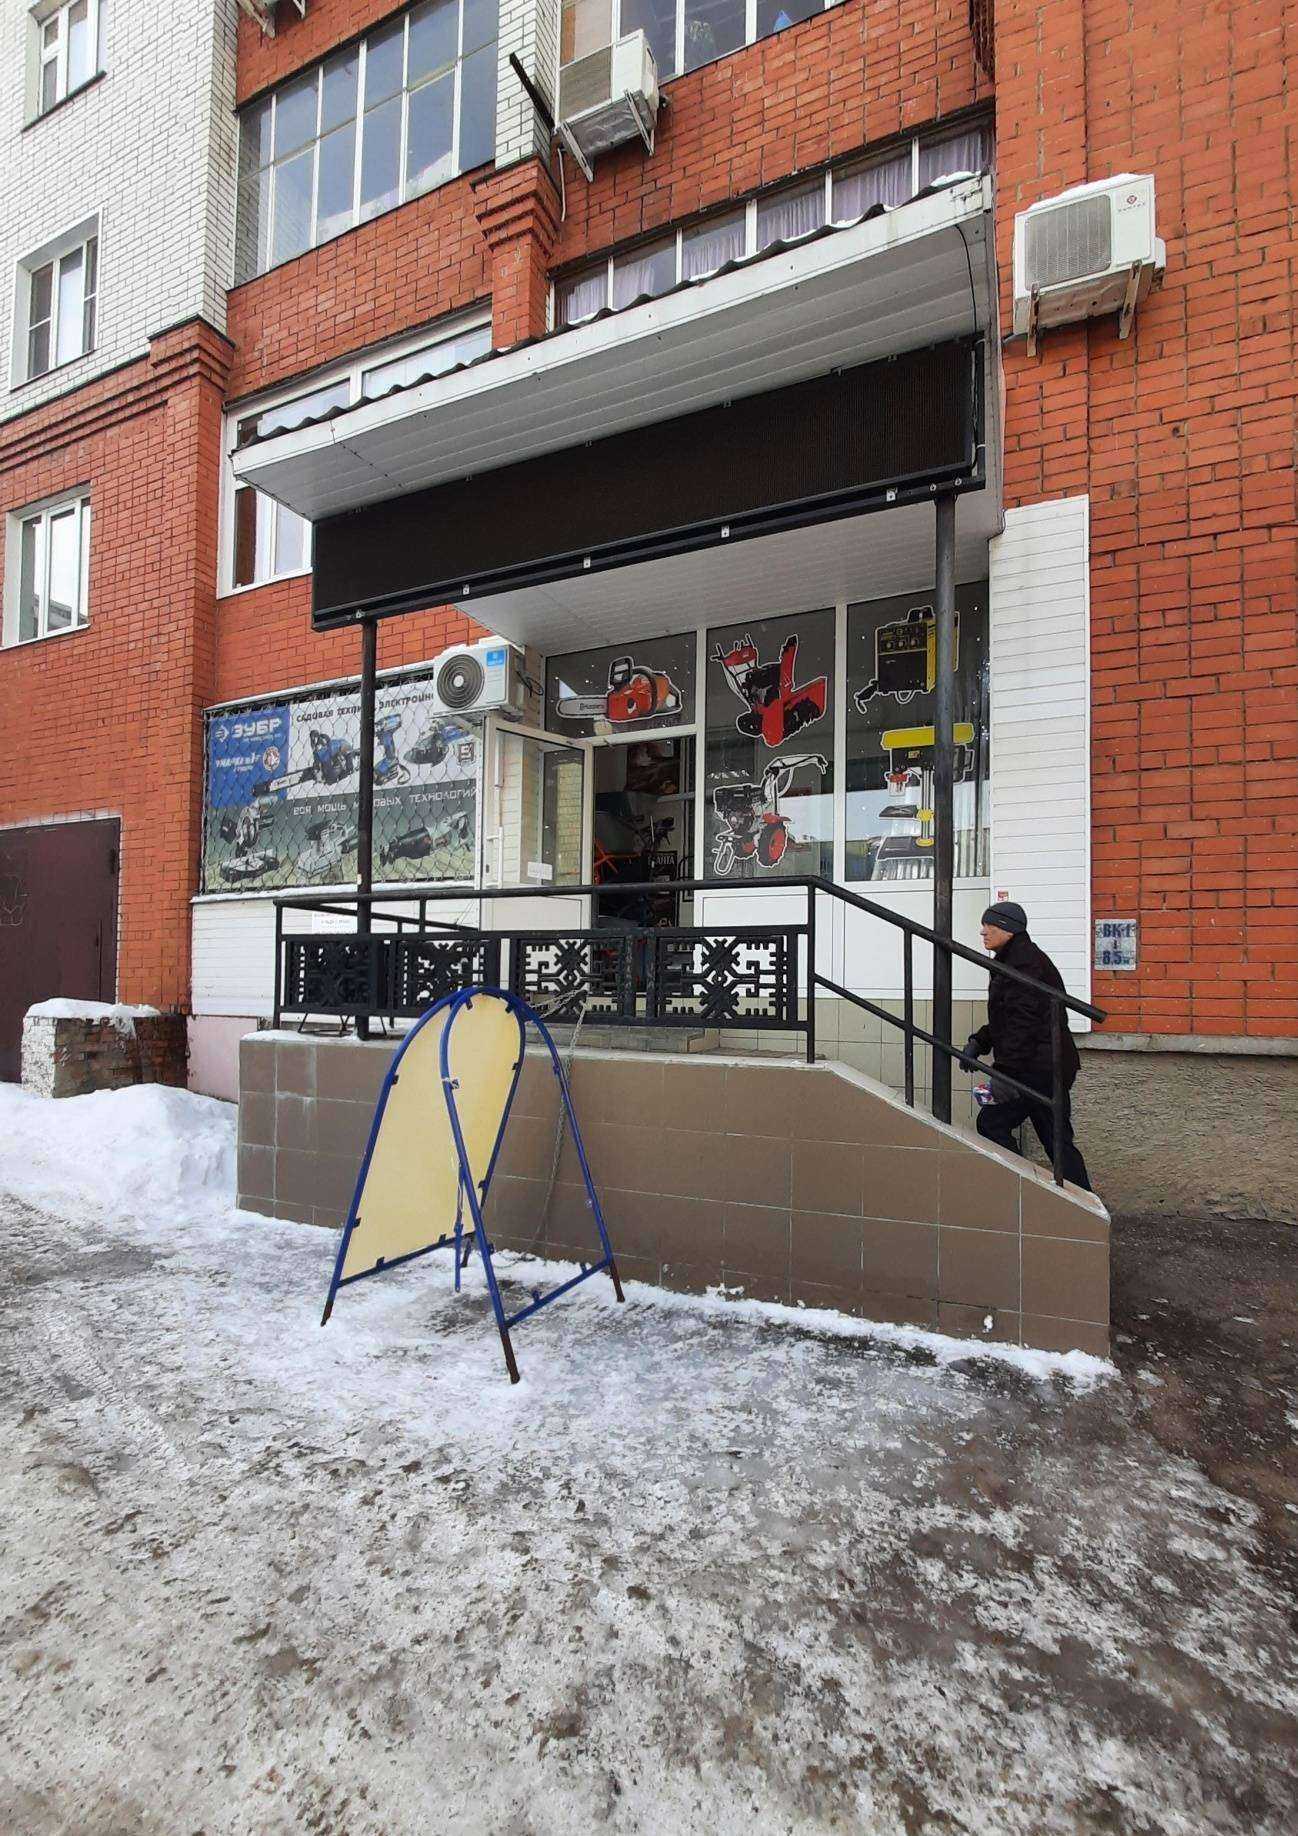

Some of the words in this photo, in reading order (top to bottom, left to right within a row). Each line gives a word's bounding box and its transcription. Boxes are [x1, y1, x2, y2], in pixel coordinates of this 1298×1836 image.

[231, 718, 282, 738] ЗУБР
[317, 804, 346, 814] МОЩЬ
[409, 788, 478, 803] ТЕХНОЛОГИЙ
